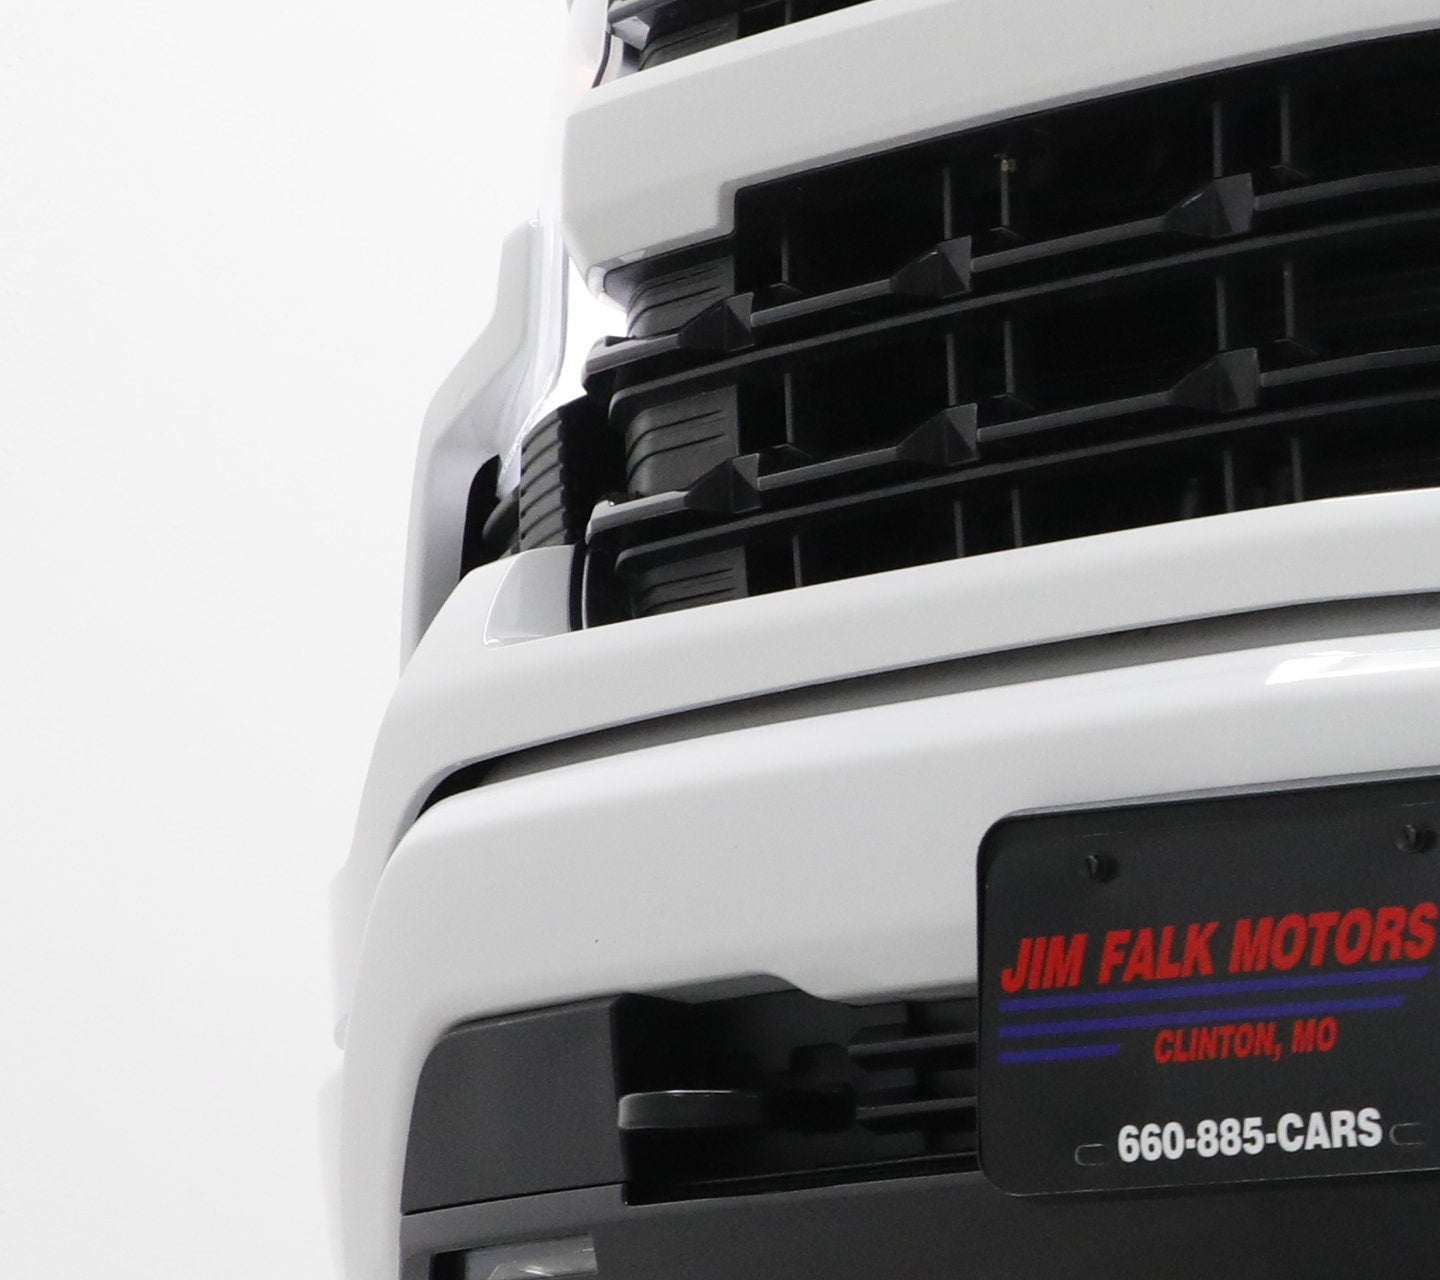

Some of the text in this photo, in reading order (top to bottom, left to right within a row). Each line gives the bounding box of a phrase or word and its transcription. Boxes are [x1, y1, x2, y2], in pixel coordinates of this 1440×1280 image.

[1000, 901, 1440, 994] JIM FALK MOTORS
[1153, 1016, 1340, 1065] CLINTON, MO
[1117, 1107, 1383, 1163] 660-885-CARS
